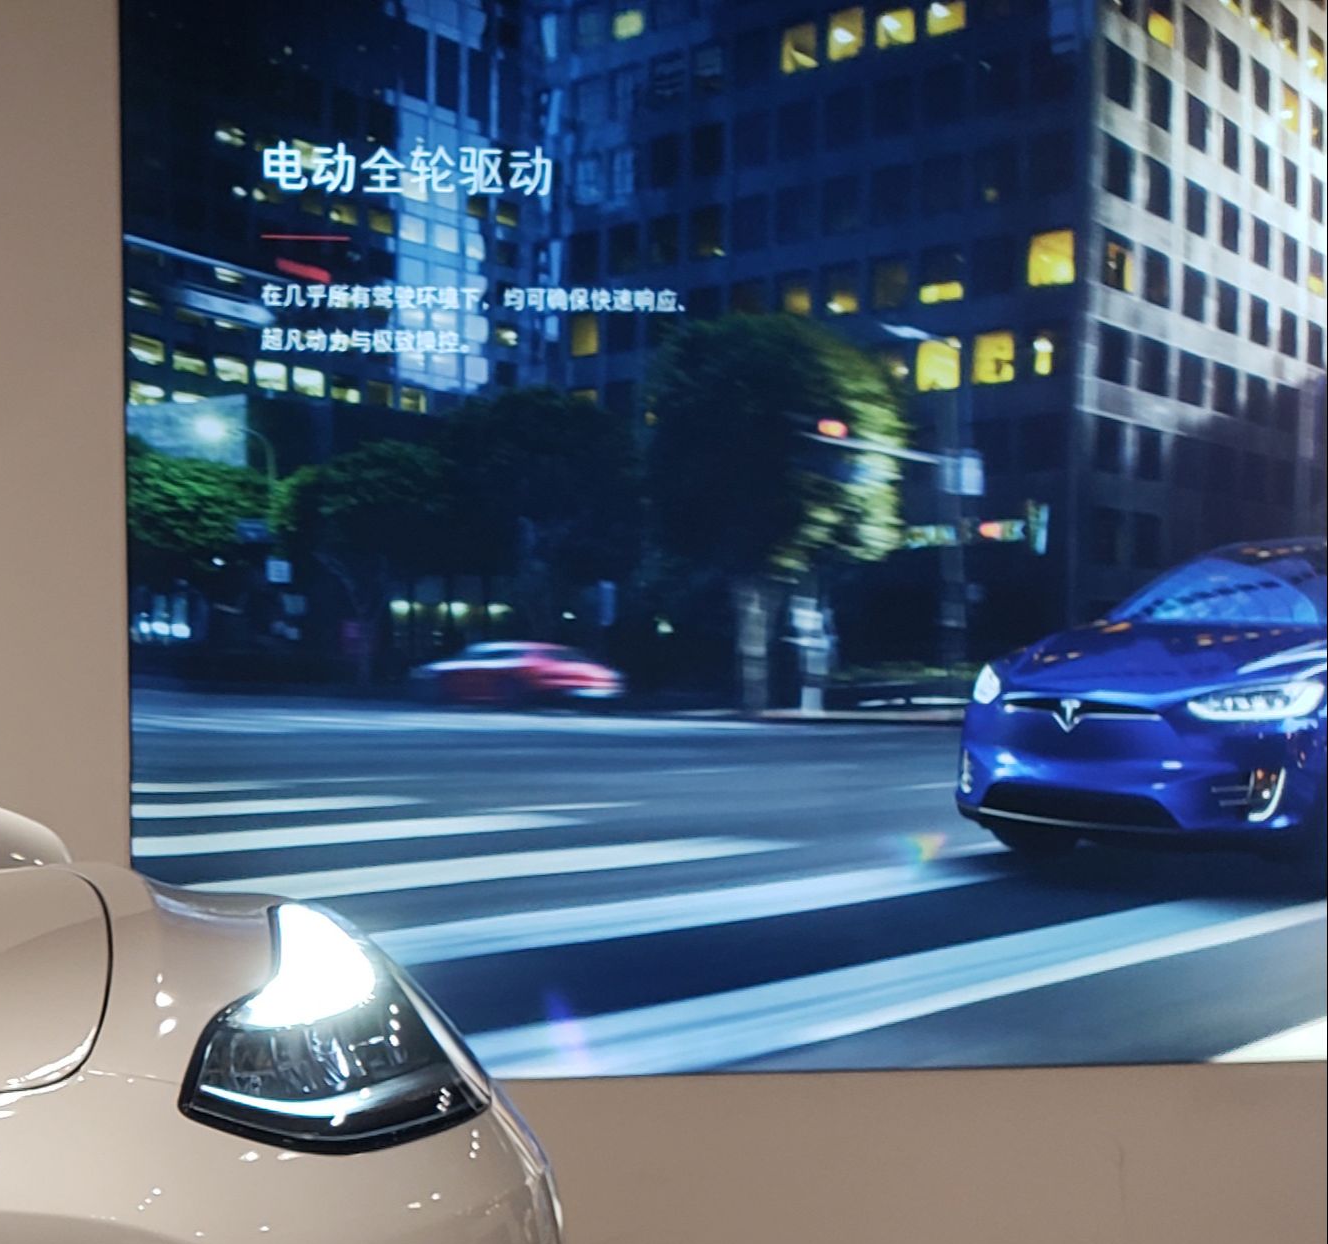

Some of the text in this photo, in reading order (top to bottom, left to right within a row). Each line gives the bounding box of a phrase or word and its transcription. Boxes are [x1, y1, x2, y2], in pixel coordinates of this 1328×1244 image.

[262, 142, 553, 196] 电动全轮驱动
